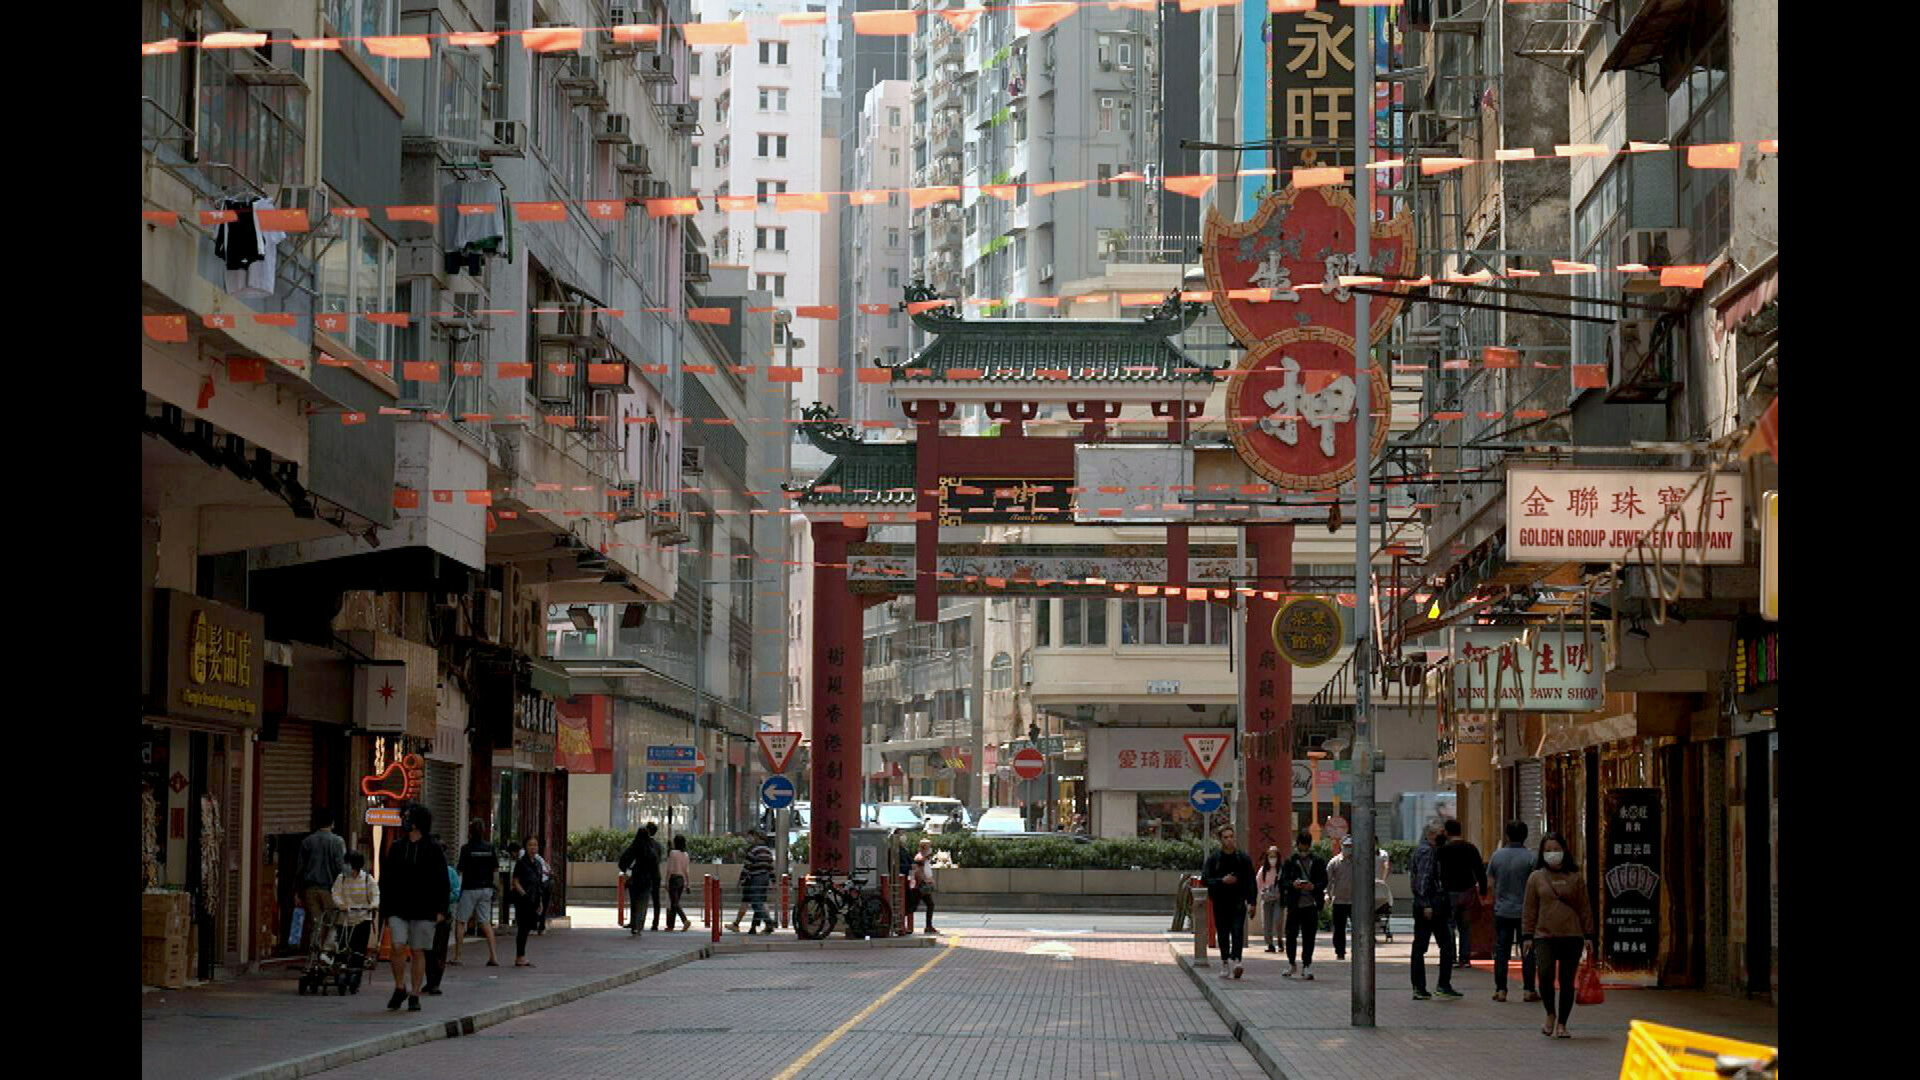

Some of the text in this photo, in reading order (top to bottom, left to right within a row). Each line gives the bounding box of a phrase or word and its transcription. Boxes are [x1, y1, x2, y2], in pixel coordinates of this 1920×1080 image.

[1286, 11, 1355, 185] 永旺
[1259, 355, 1357, 457] 押
[1520, 484, 1733, 520] 金聯珠寶行
[1519, 528, 1564, 547] GOLDEN
[1567, 528, 1607, 548] GROUP
[1530, 687, 1563, 699] PAWN
[1567, 687, 1598, 700] SHOP
[1118, 749, 1192, 769] 愛琦麗
